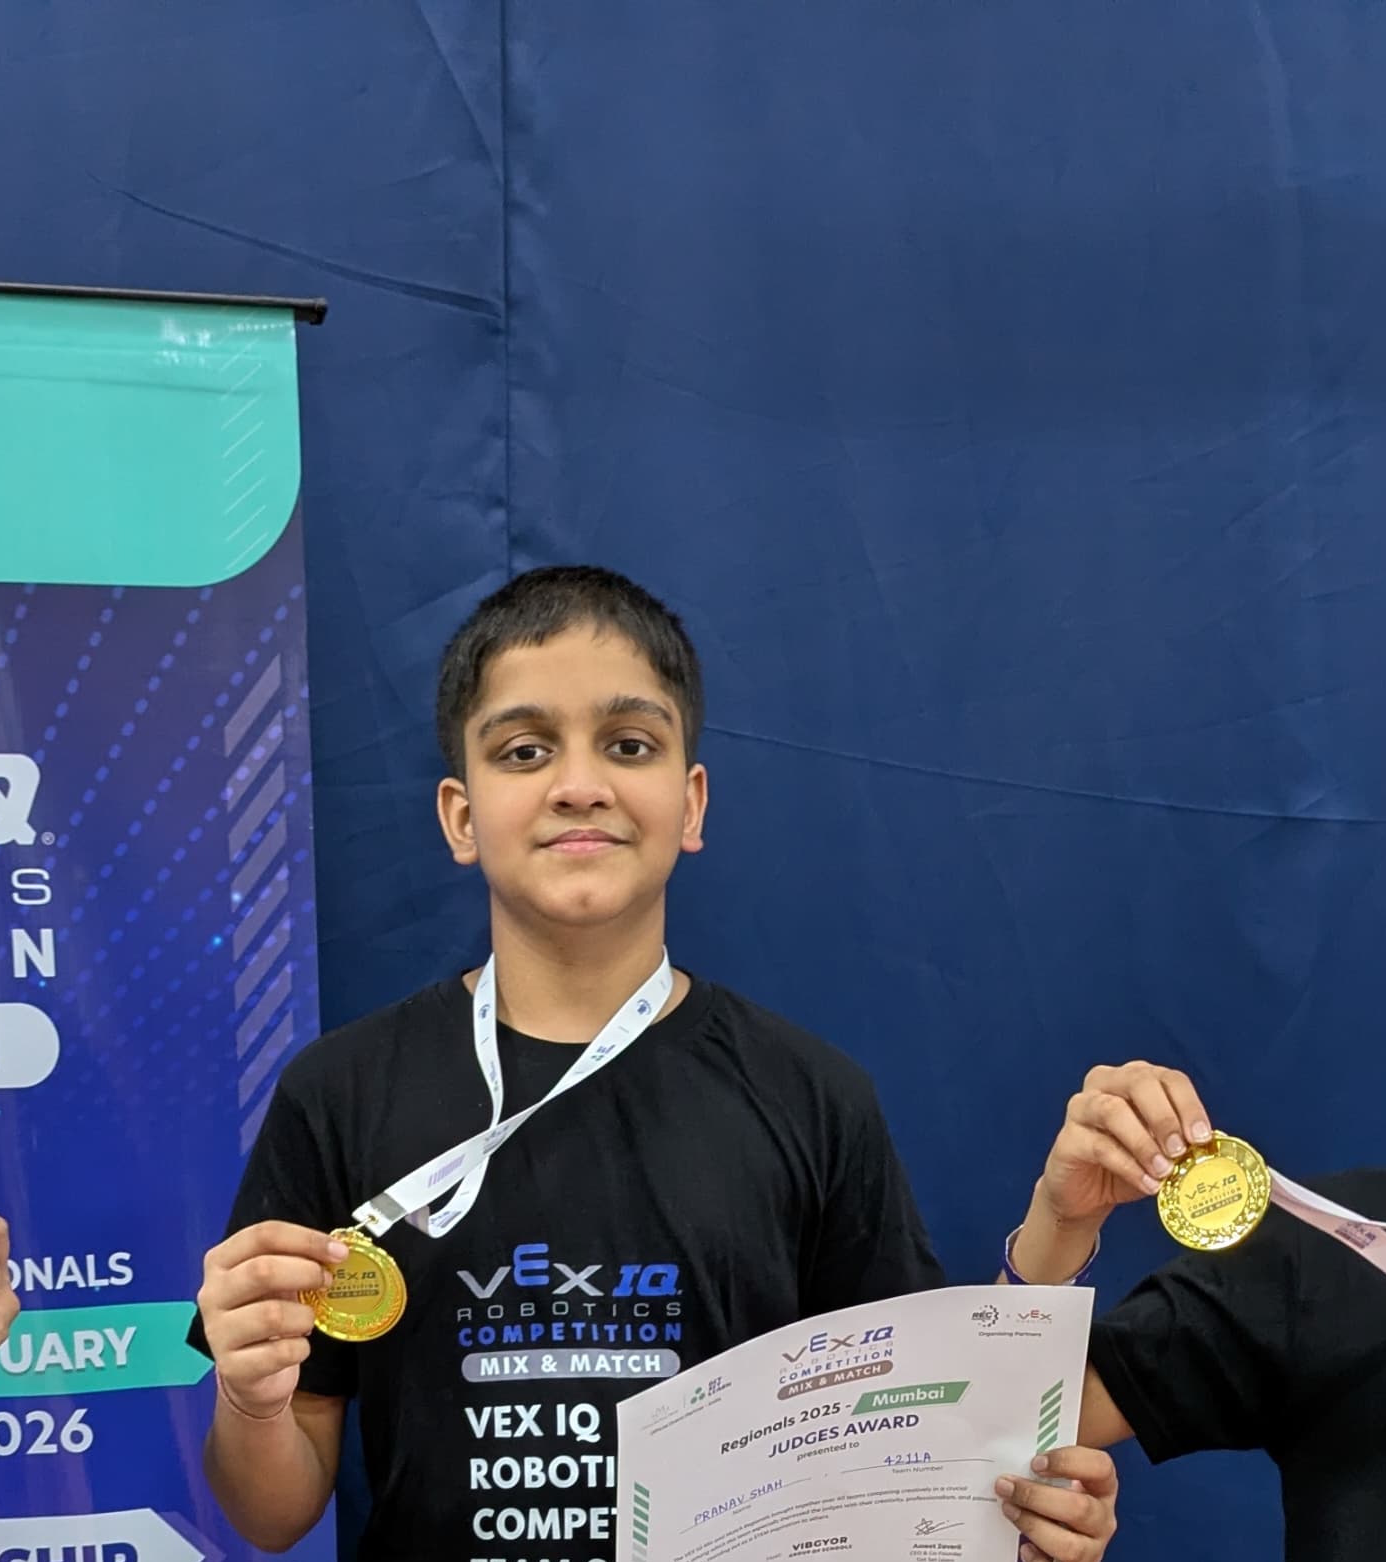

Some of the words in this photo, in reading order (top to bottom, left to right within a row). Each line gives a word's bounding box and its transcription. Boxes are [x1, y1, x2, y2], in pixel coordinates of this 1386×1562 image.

[611, 1263, 679, 1297] IQ
[457, 1301, 682, 1323] ROBOTICS
[458, 1322, 682, 1348] COMPETITION
[859, 1326, 894, 1345] IQ
[479, 1355, 530, 1377] MIX
[540, 1354, 559, 1374] &
[569, 1353, 662, 1374] MATCH
[779, 1348, 894, 1385] COMPETITION
[788, 1380, 814, 1396] MIX
[818, 1376, 828, 1387] &
[833, 1364, 882, 1383] MATCH
[464, 1403, 545, 1439] VEX
[556, 1403, 602, 1443] IQ
[720, 1414, 796, 1455] Regionals
[799, 1402, 842, 1424] 2025
[872, 1387, 945, 1408] Mumbai
[768, 1426, 840, 1458] JUDGES
[843, 1414, 920, 1437] AWARD
[796, 1442, 847, 1462] presented
[848, 1440, 860, 1450] to
[469, 1455, 615, 1490] ROBOTI
[694, 1495, 746, 1526] PRANAV
[749, 1479, 784, 1502] SHAH
[472, 1506, 617, 1541] COMPE
[792, 1536, 849, 1551] VIBGYOR
